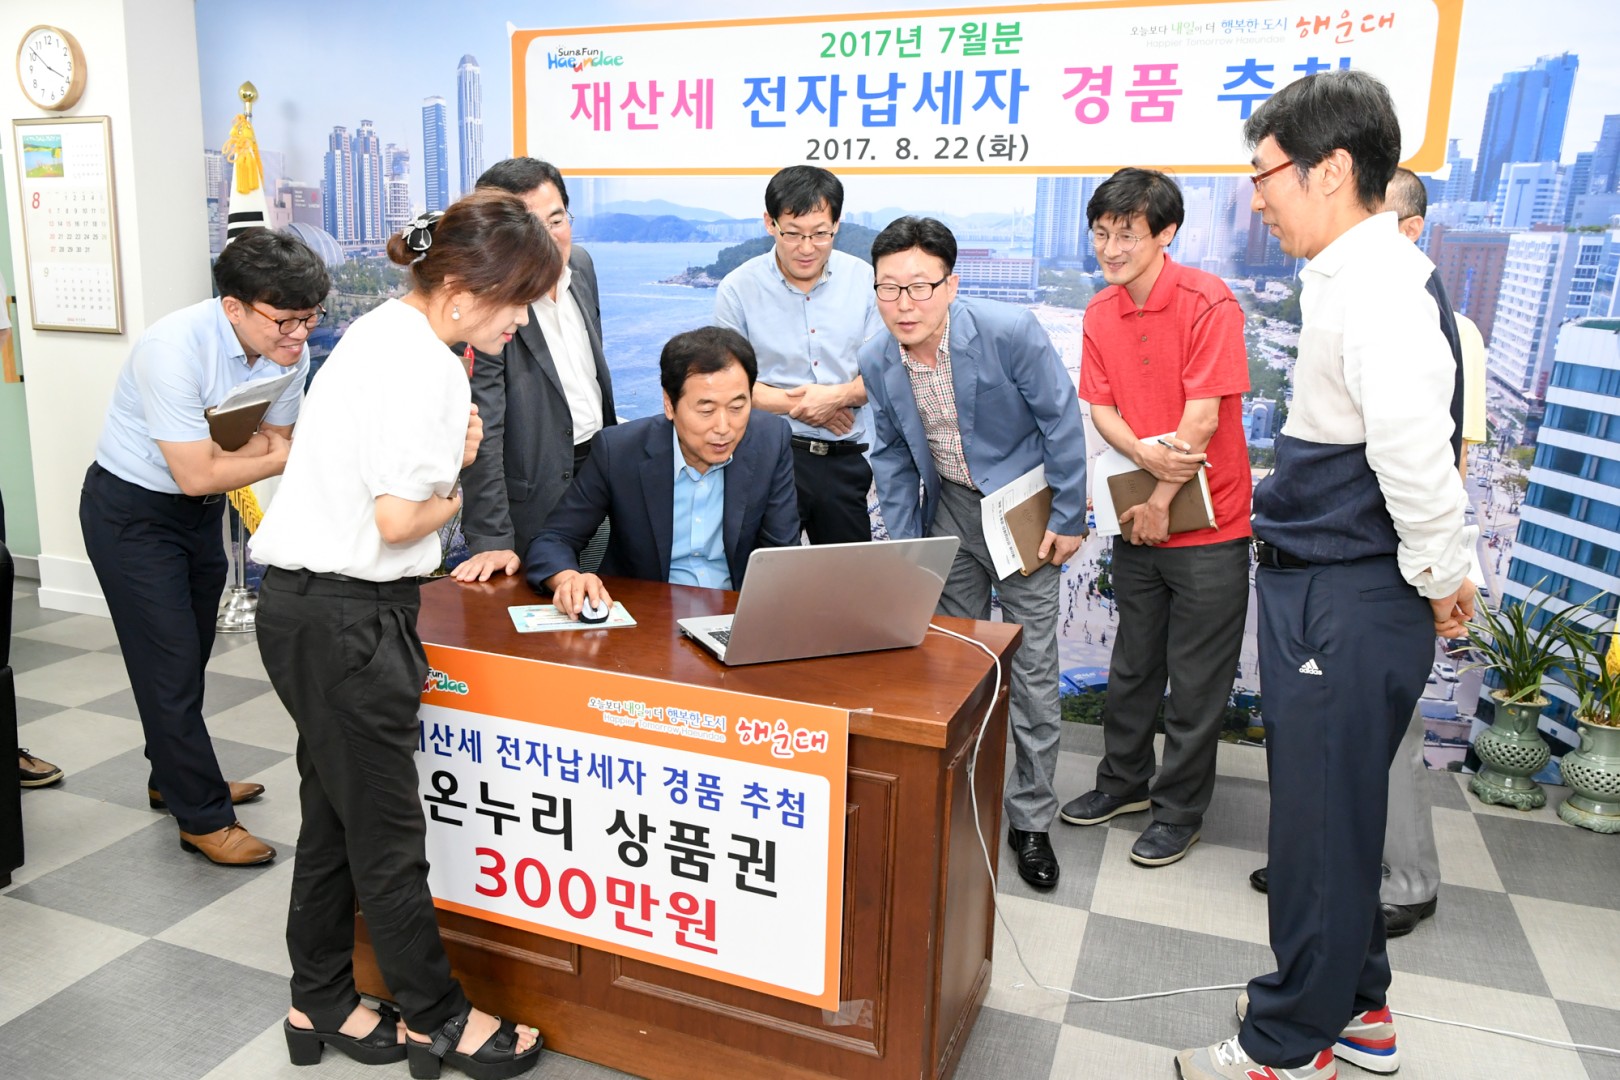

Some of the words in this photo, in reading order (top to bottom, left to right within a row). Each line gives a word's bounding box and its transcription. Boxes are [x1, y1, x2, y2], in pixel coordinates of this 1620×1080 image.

[1221, 19, 1260, 34] 행복한
[1261, 17, 1287, 31] 도시
[1296, 9, 1395, 44] 해운대
[36, 41, 42, 50] 11
[44, 35, 52, 45] 12
[56, 39, 60, 48] 1
[821, 25, 922, 58] 2017년
[938, 21, 1023, 57] 7월분
[63, 47, 68, 56] 2
[558, 47, 599, 56] Sun&Fun
[67, 61, 72, 71] 3
[547, 50, 624, 72] Haeundae
[29, 65, 33, 74] 9
[33, 79, 37, 88] 8
[65, 76, 71, 84] 4
[41, 88, 45, 98] 7
[51, 91, 55, 100] 6
[60, 86, 64, 95] 5
[570, 78, 714, 132] 재산세
[742, 68, 1030, 128] 전자납세자
[1062, 63, 1183, 125] 경품
[1217, 57, 1352, 120] 추
[806, 138, 876, 161] 2017.
[895, 137, 919, 160] 8.
[934, 134, 1029, 162] 22(화)
[32, 191, 41, 210] 8
[667, 708, 701, 728] 행복한
[702, 714, 727, 731] 도시
[738, 720, 826, 756] 해운대
[496, 735, 647, 796] 전자납세자
[663, 767, 724, 812] 경품
[740, 782, 805, 829] 추첨
[424, 770, 573, 852] 온누리
[606, 809, 778, 899] 상품권
[474, 846, 719, 955] 300만원
